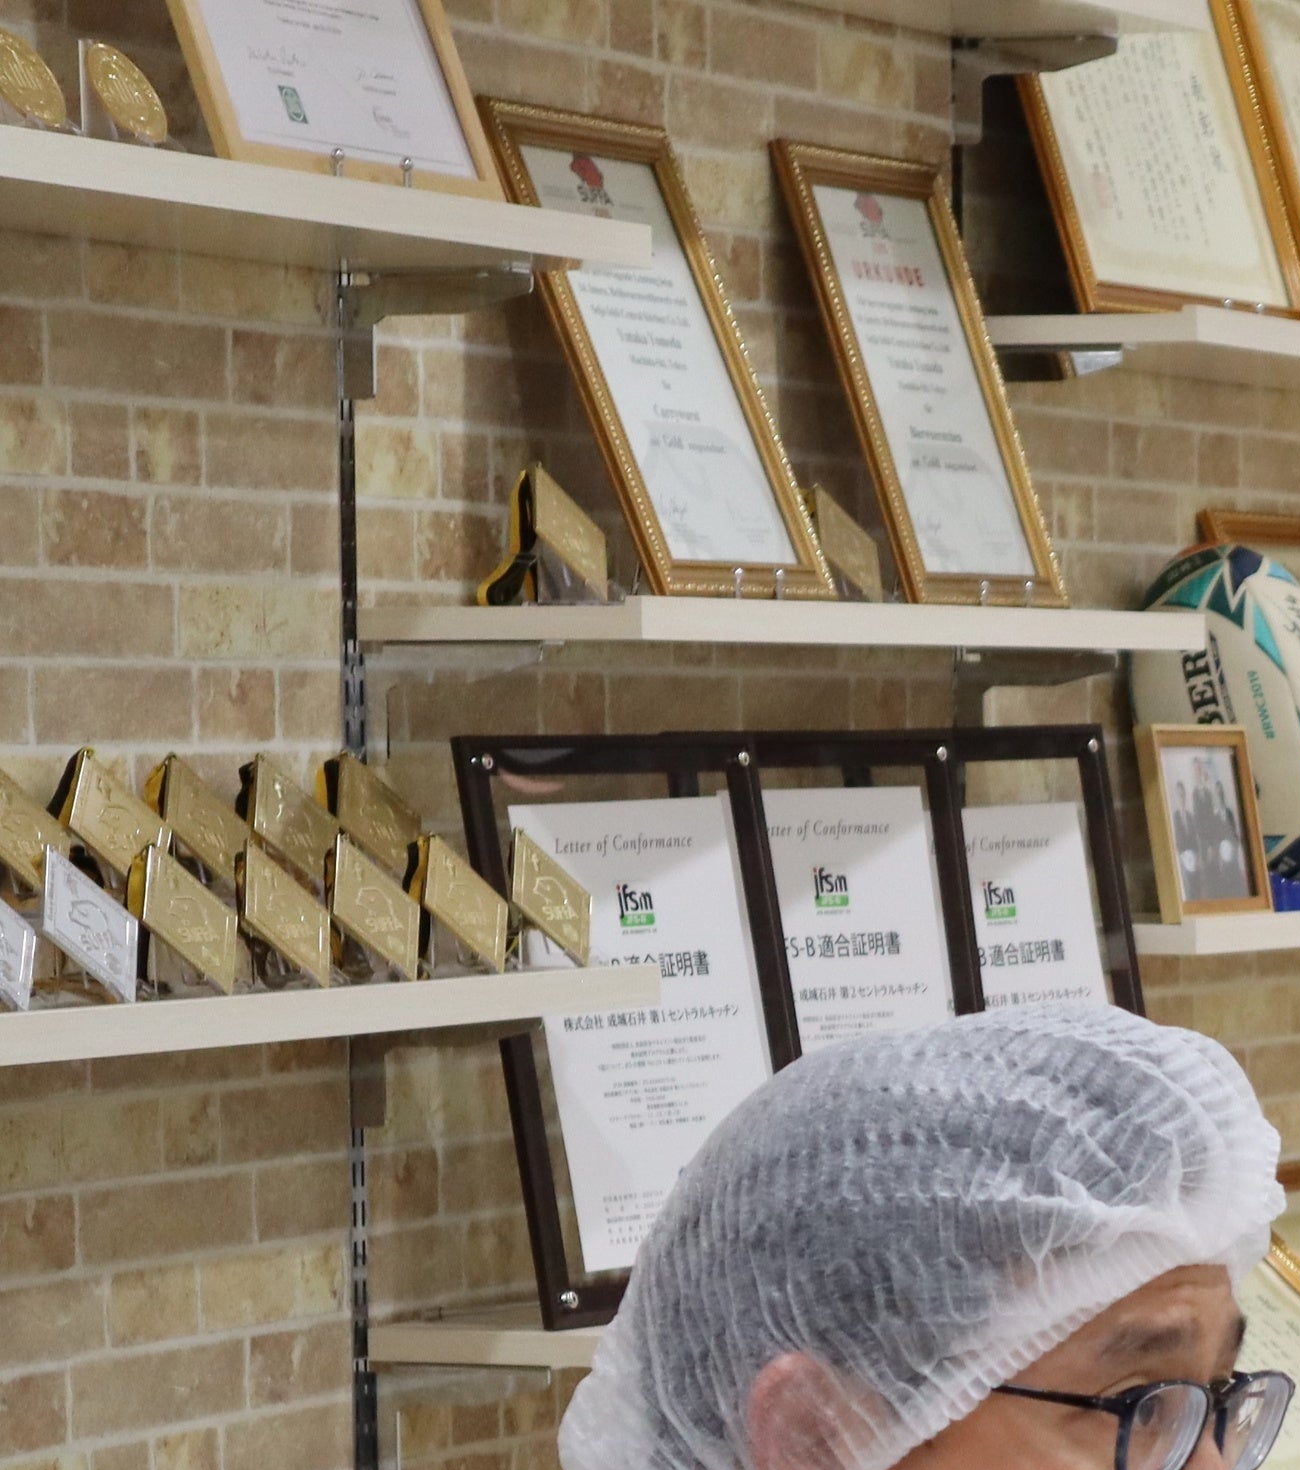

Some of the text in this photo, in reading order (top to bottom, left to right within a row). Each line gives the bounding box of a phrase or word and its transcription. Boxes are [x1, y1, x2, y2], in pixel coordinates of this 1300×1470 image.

[767, 818, 890, 841] etter of Conformance
[555, 832, 693, 857] Letter of Conformance
[980, 833, 1050, 856] Conformance
